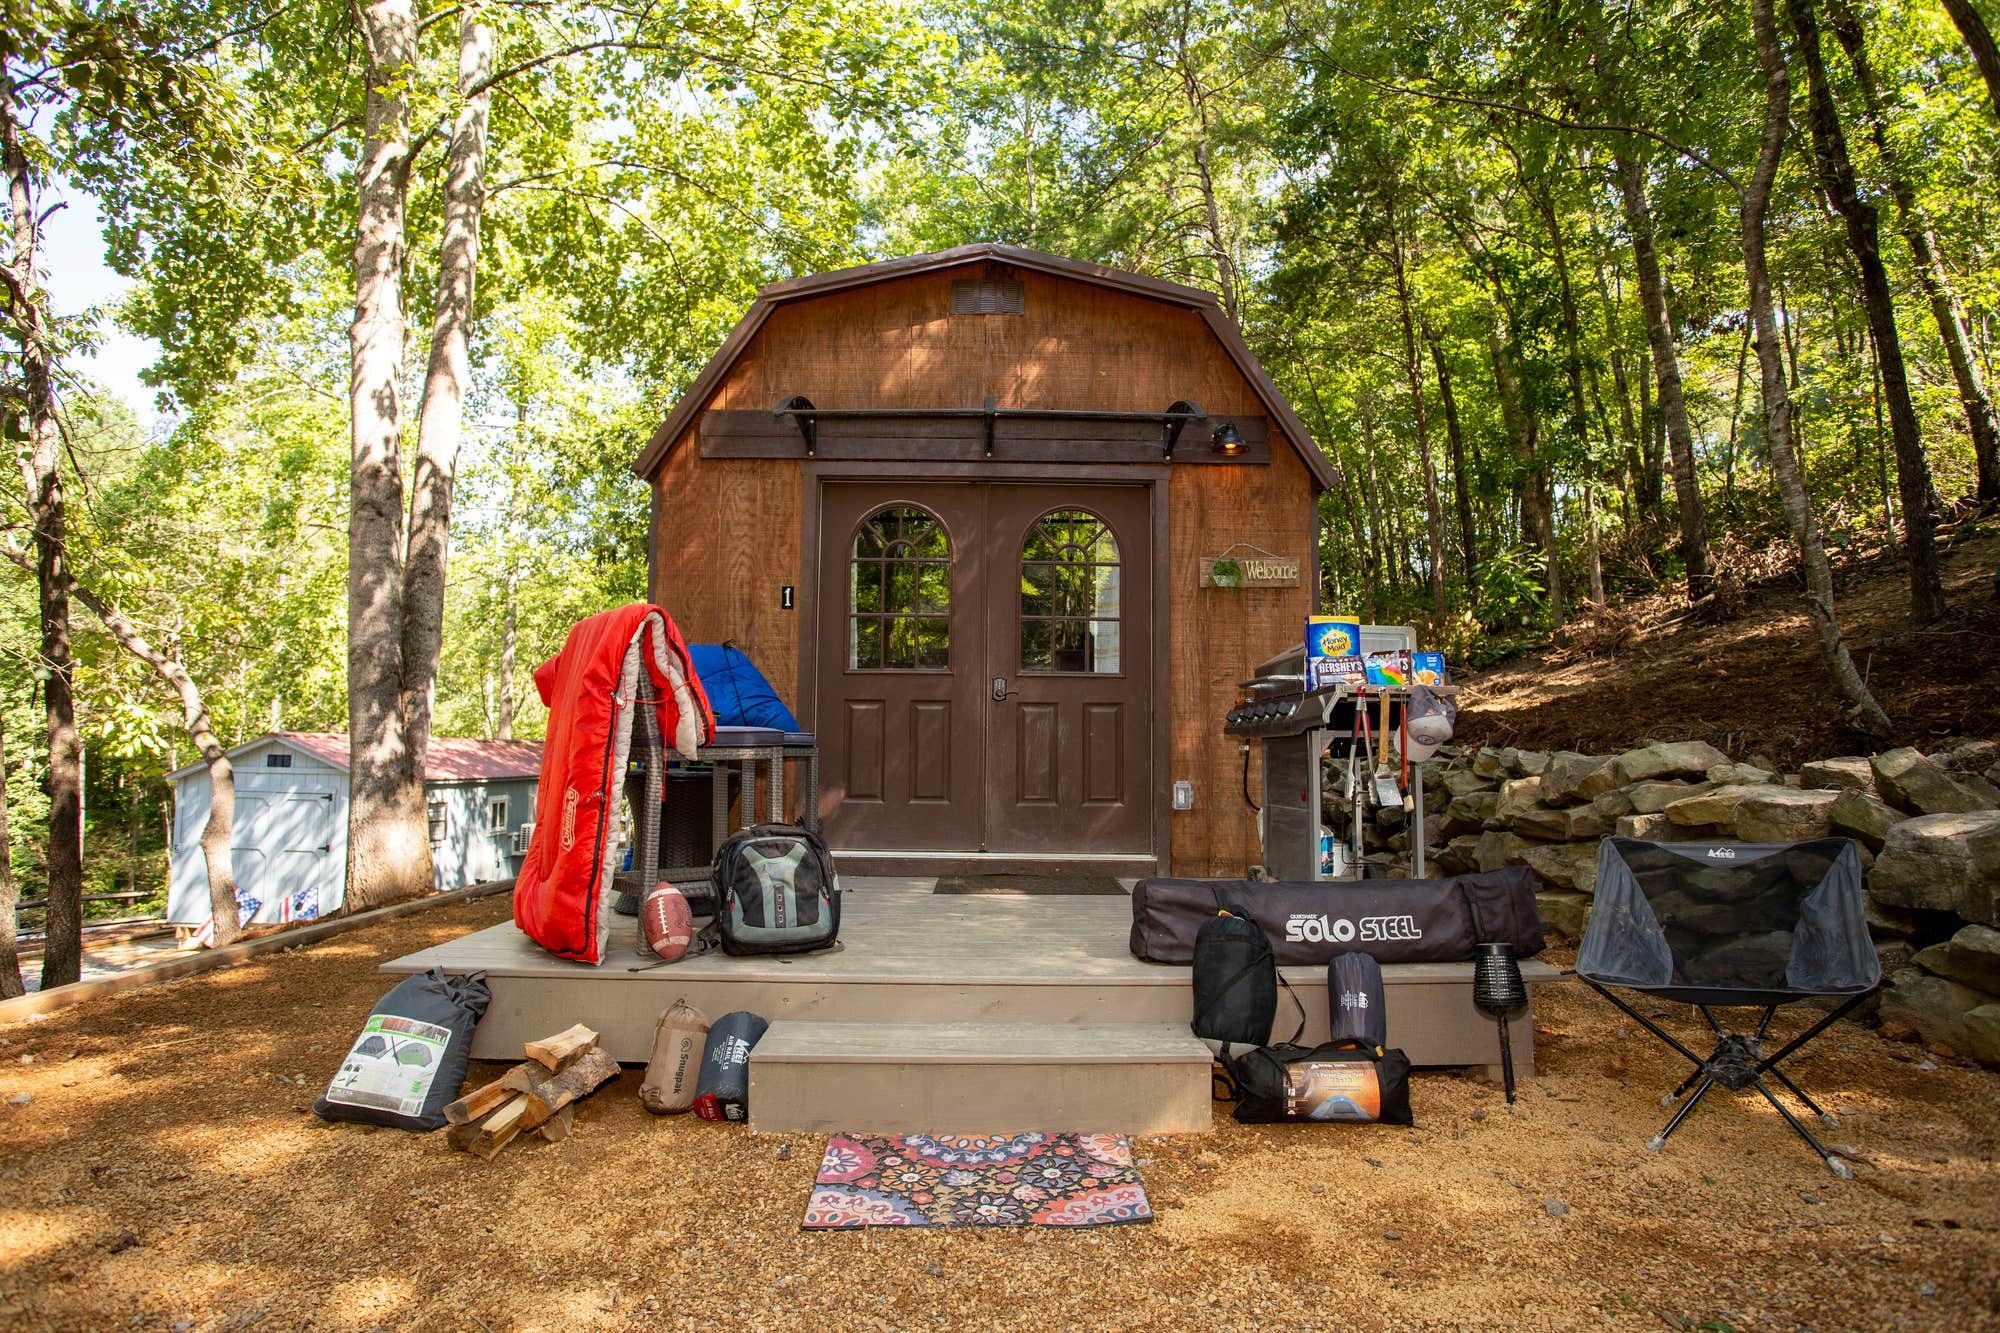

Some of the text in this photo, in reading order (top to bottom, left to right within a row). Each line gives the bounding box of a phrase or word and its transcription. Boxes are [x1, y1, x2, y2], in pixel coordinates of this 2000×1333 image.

[1245, 560, 1298, 580] Welcome
[784, 587, 791, 607] 1
[1322, 635, 1348, 646] Honey
[1327, 643, 1346, 652] Maid
[1319, 661, 1363, 673] HERSHEY'S
[1359, 915, 1422, 941] STEEL
[725, 1047, 733, 1061] RAIL
[673, 1054, 689, 1095] Snugpak
